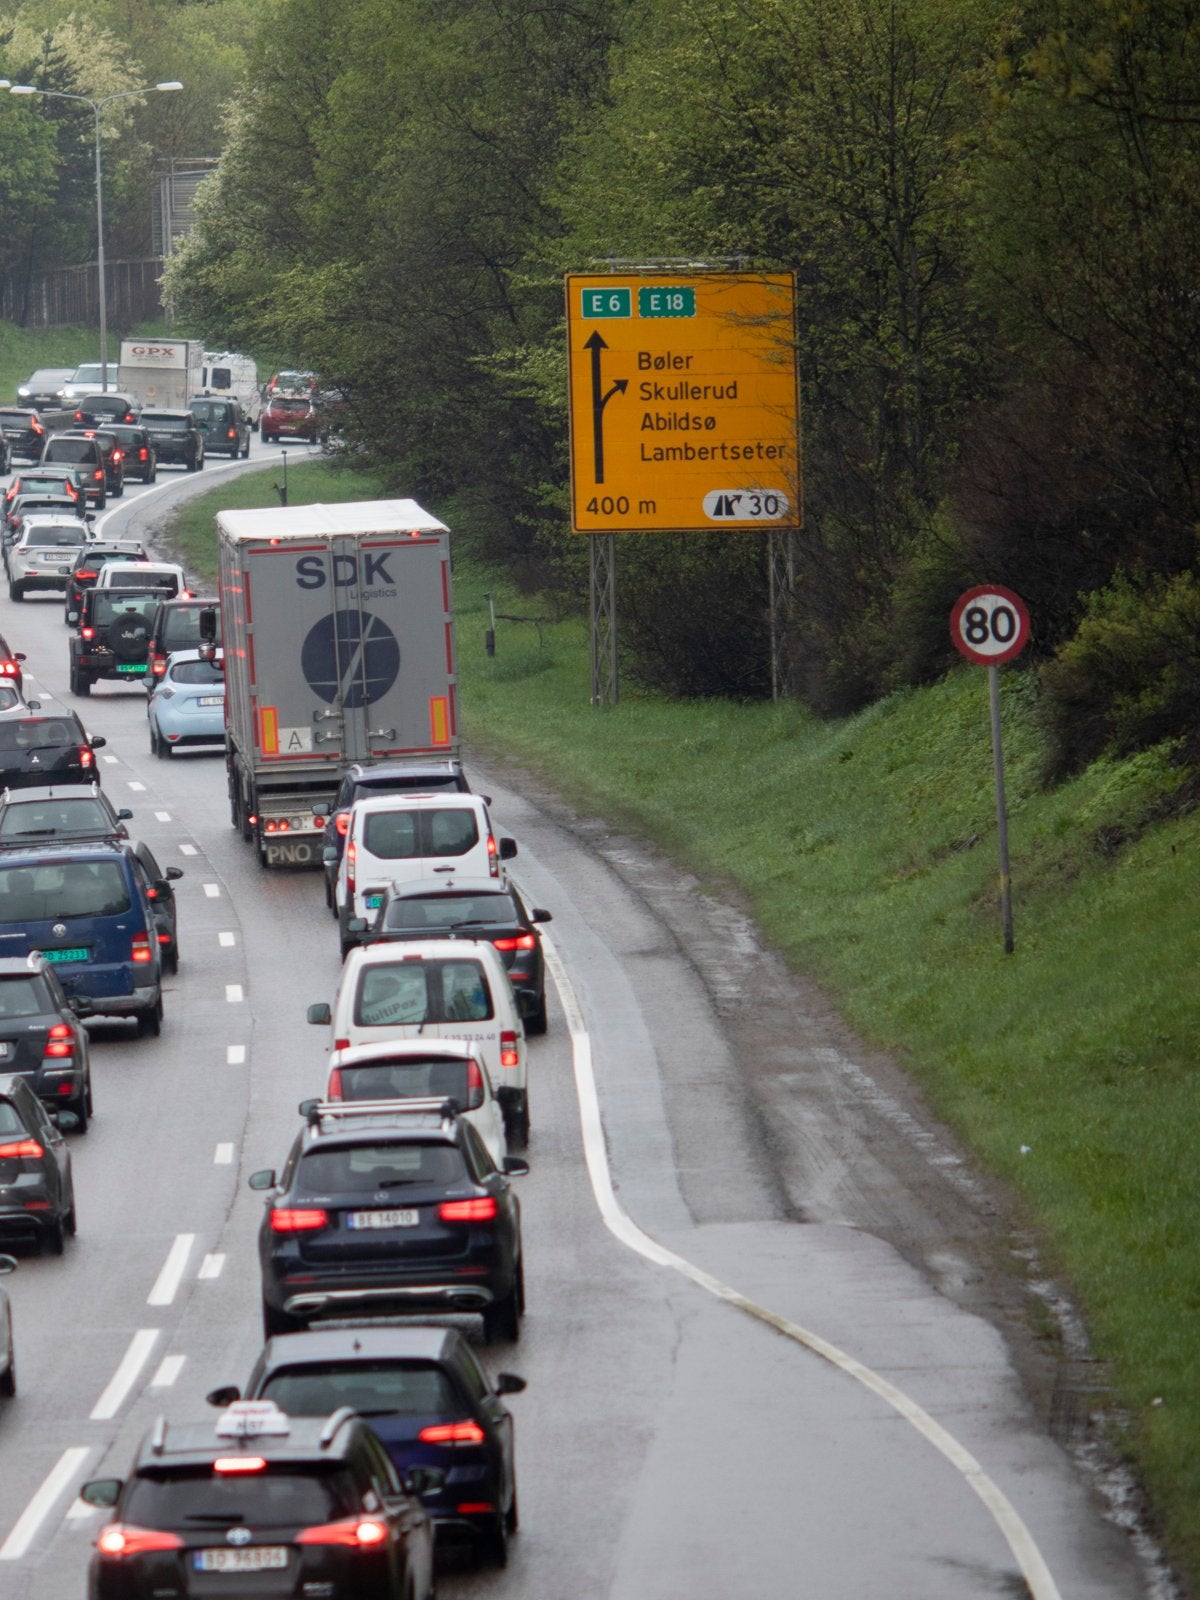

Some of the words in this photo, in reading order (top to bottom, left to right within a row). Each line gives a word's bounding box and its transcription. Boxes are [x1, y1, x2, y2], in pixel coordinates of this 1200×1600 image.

[132, 347, 174, 356] GPX
[638, 351, 693, 371] Bøler
[639, 381, 738, 401] Skullerud
[640, 412, 716, 431] Abildsø
[640, 442, 786, 461] Lambertseter
[586, 496, 630, 515] 400
[639, 499, 657, 515] m
[749, 495, 779, 515] 30
[296, 552, 396, 590] SDK
[965, 605, 1016, 645] 80
[288, 730, 303, 750] A
[267, 843, 312, 864] PNO
